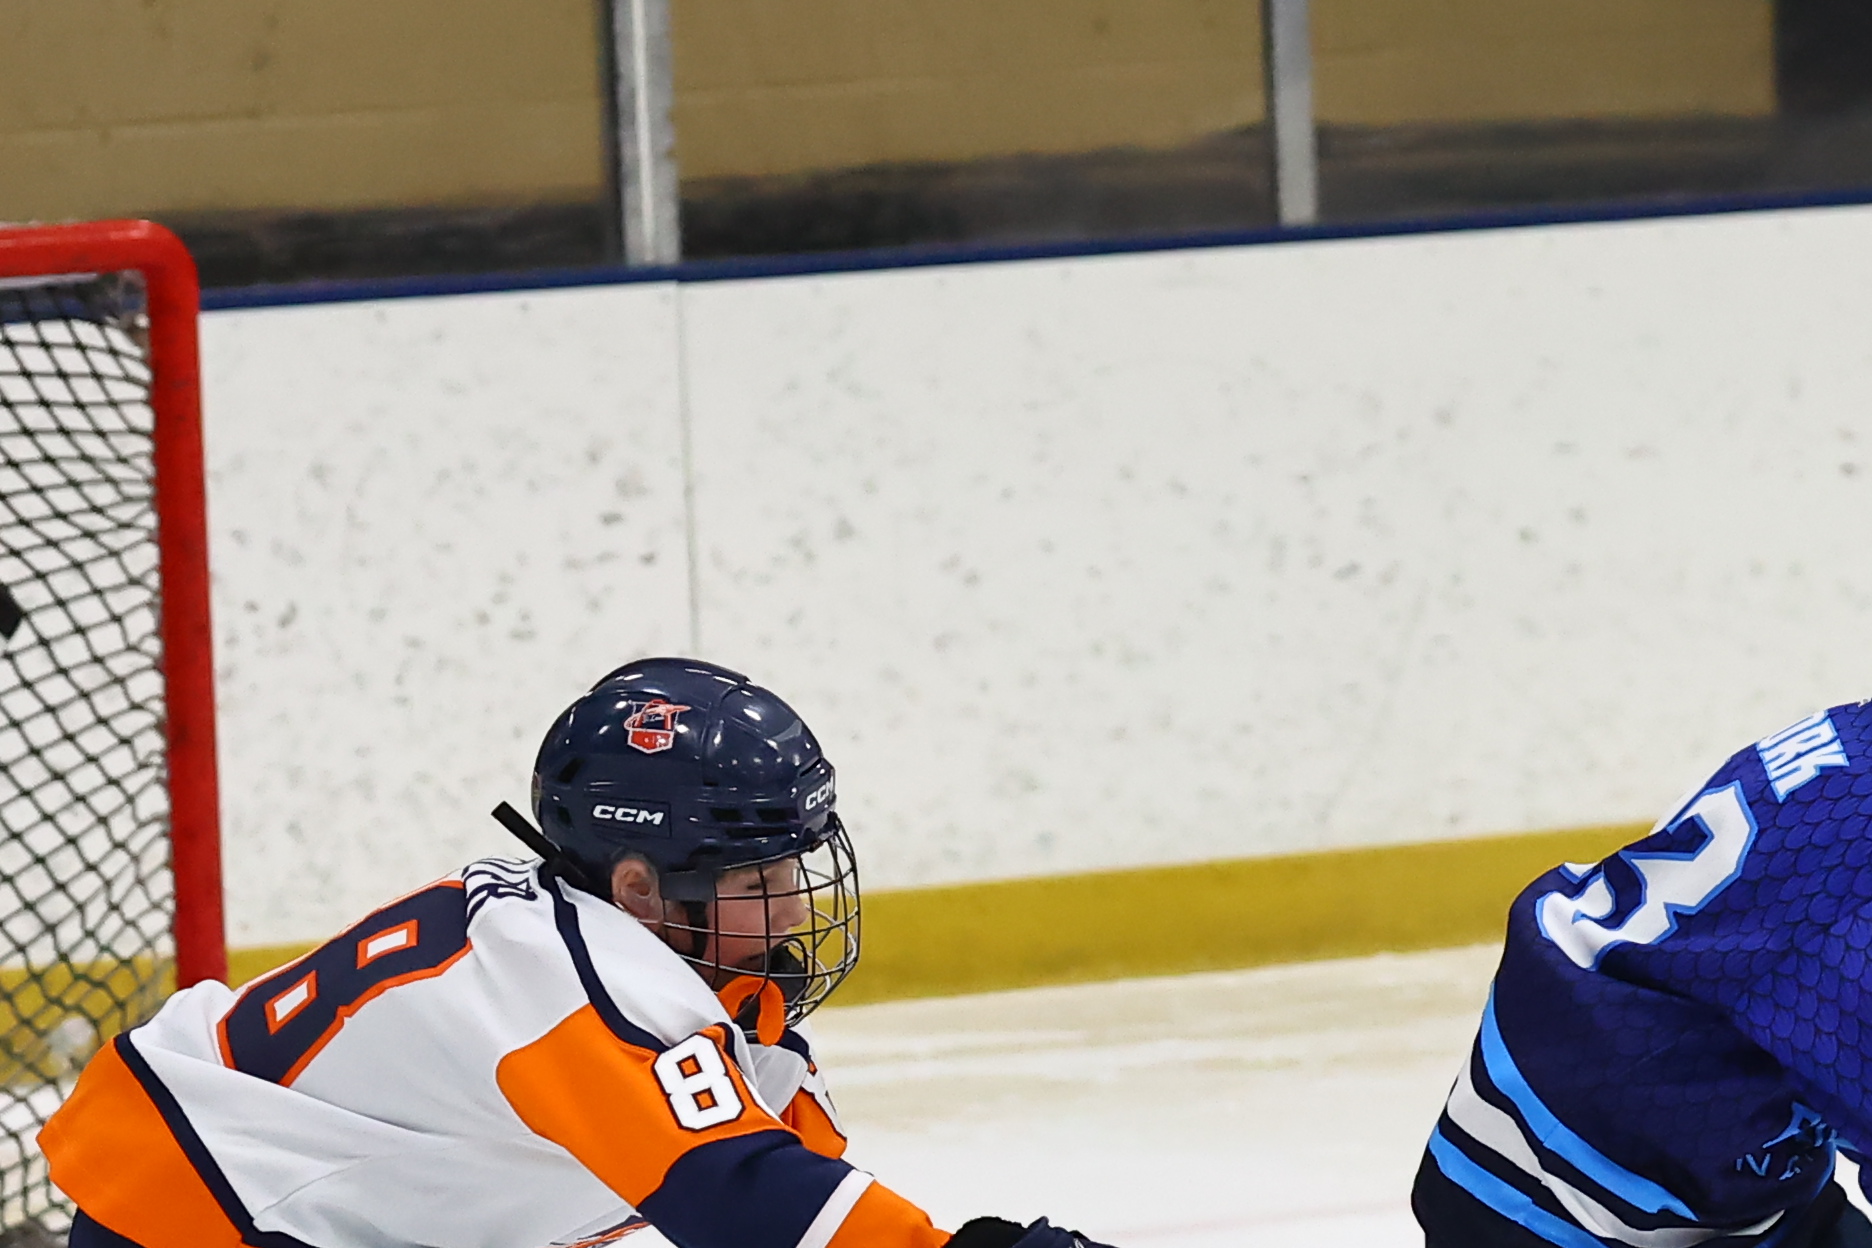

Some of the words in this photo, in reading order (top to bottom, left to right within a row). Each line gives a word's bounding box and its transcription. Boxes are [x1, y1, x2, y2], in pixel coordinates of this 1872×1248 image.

[593, 805, 664, 825] CCM
[1535, 779, 1759, 972] 3
[216, 876, 473, 1088] 8
